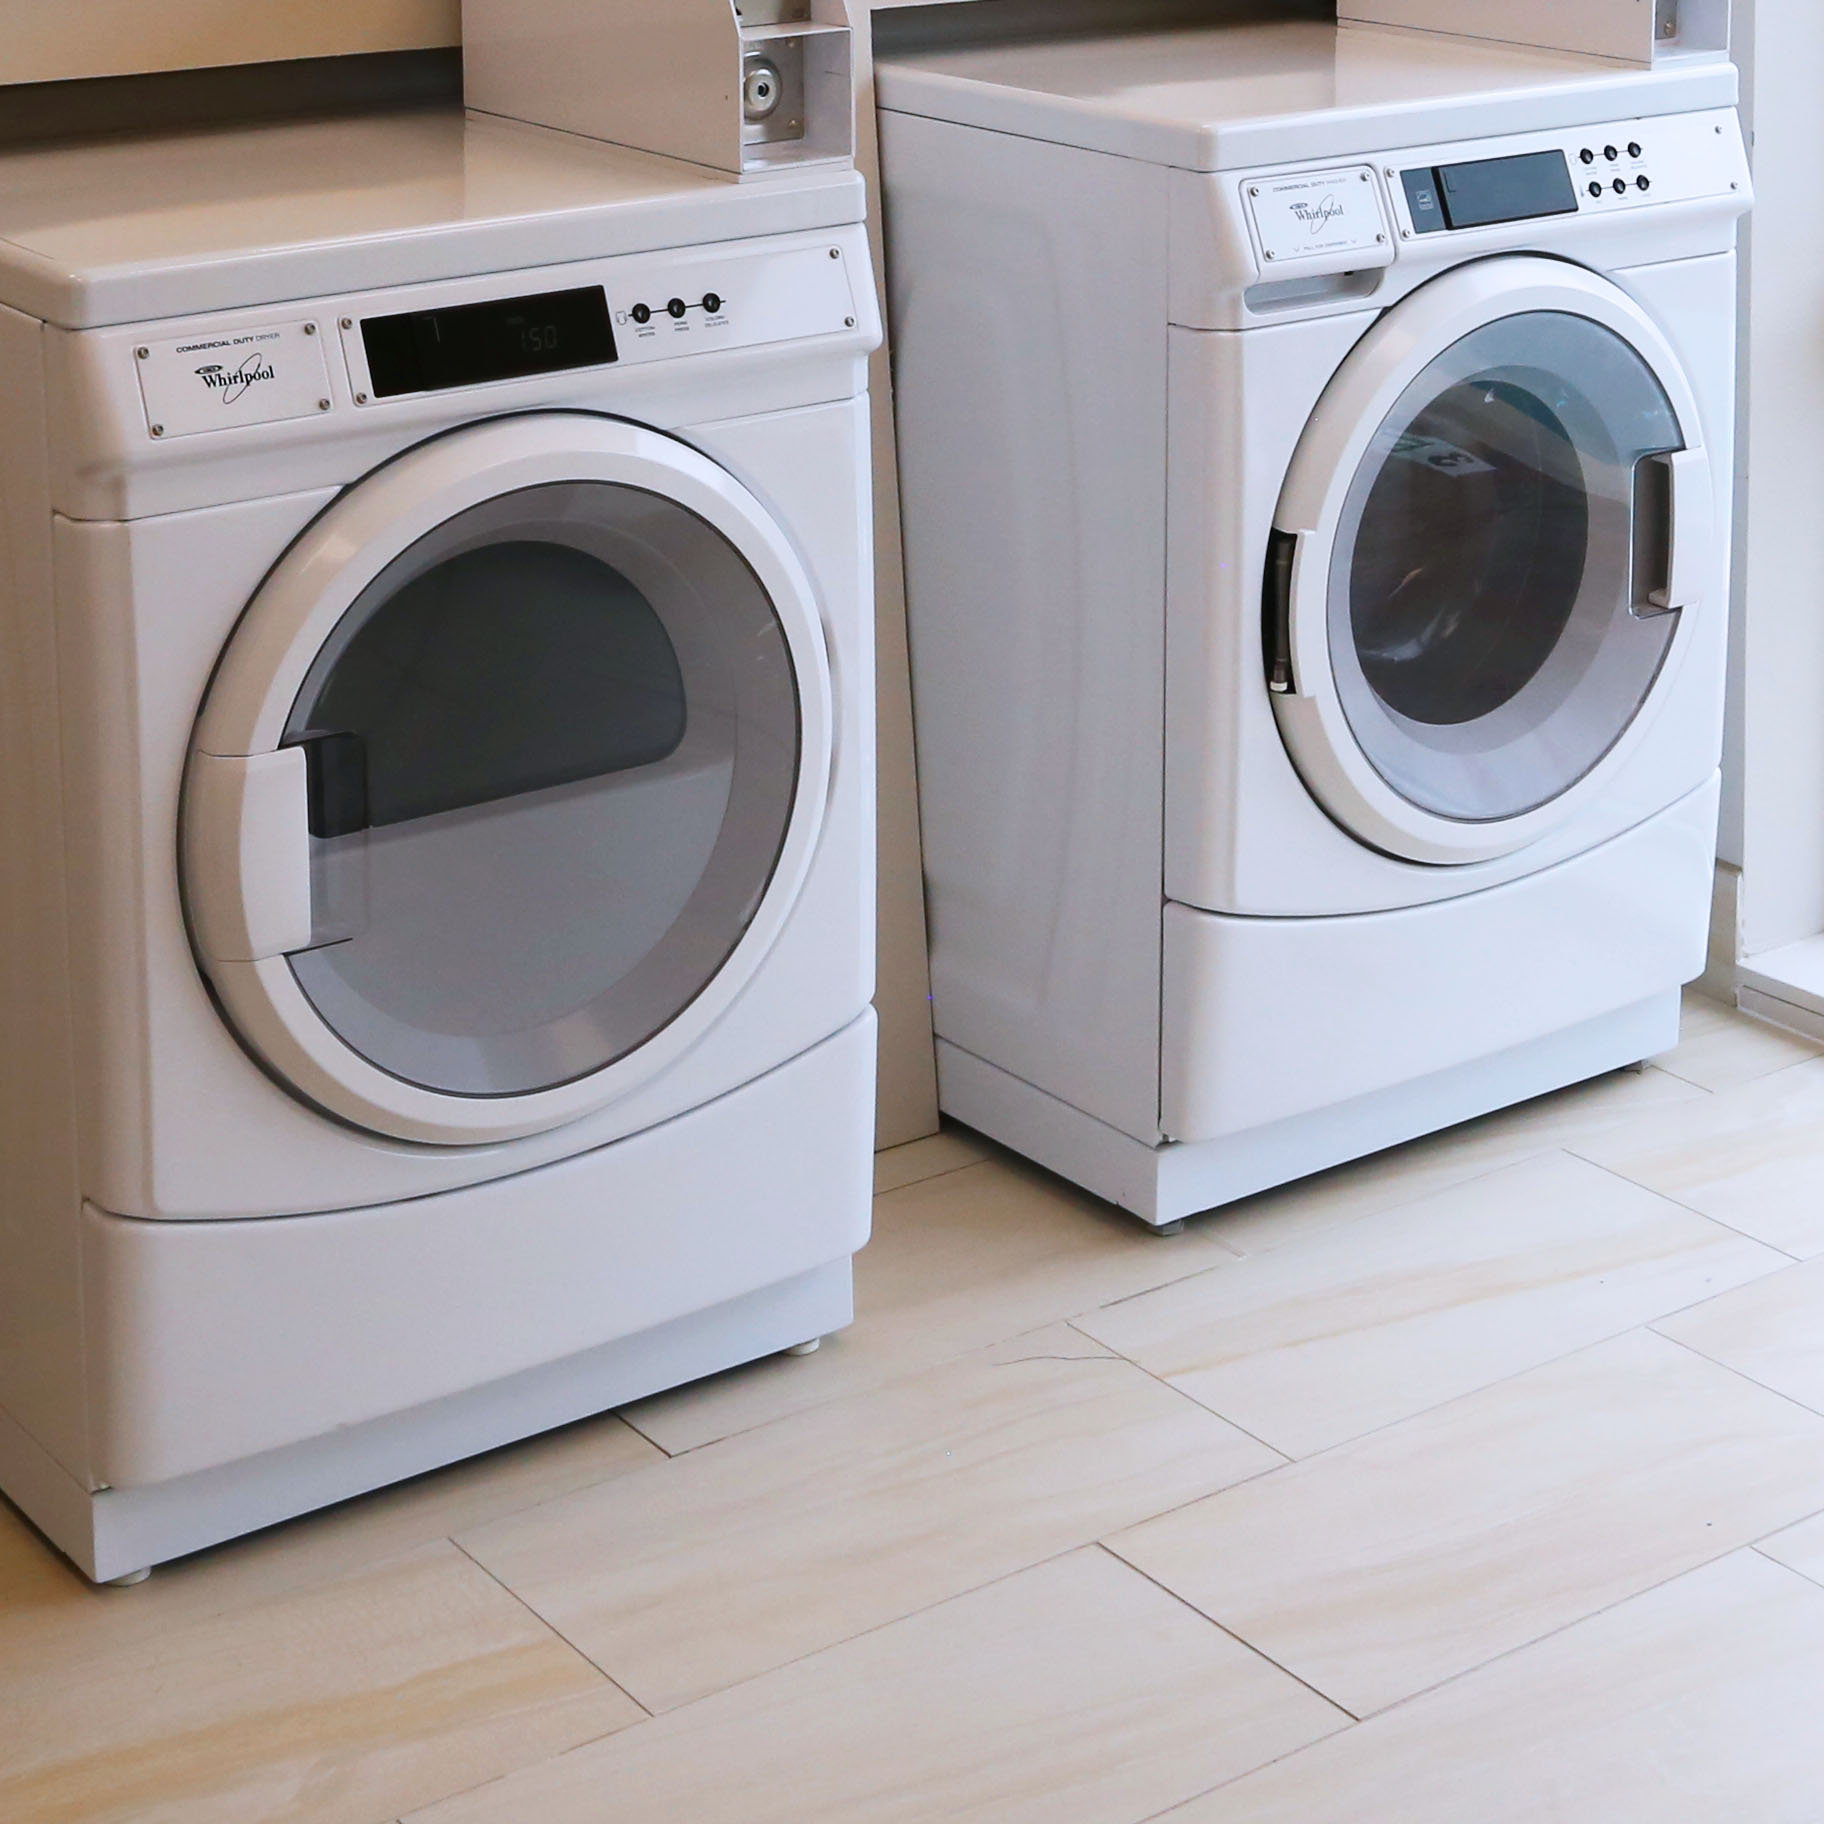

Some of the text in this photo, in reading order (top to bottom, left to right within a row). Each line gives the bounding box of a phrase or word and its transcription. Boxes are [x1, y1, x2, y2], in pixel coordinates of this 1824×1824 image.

[1294, 204, 1345, 221] Whirlpool
[176, 332, 281, 353] COMMERCIAL DUTY DRYER
[202, 365, 276, 388] Whirlpool
